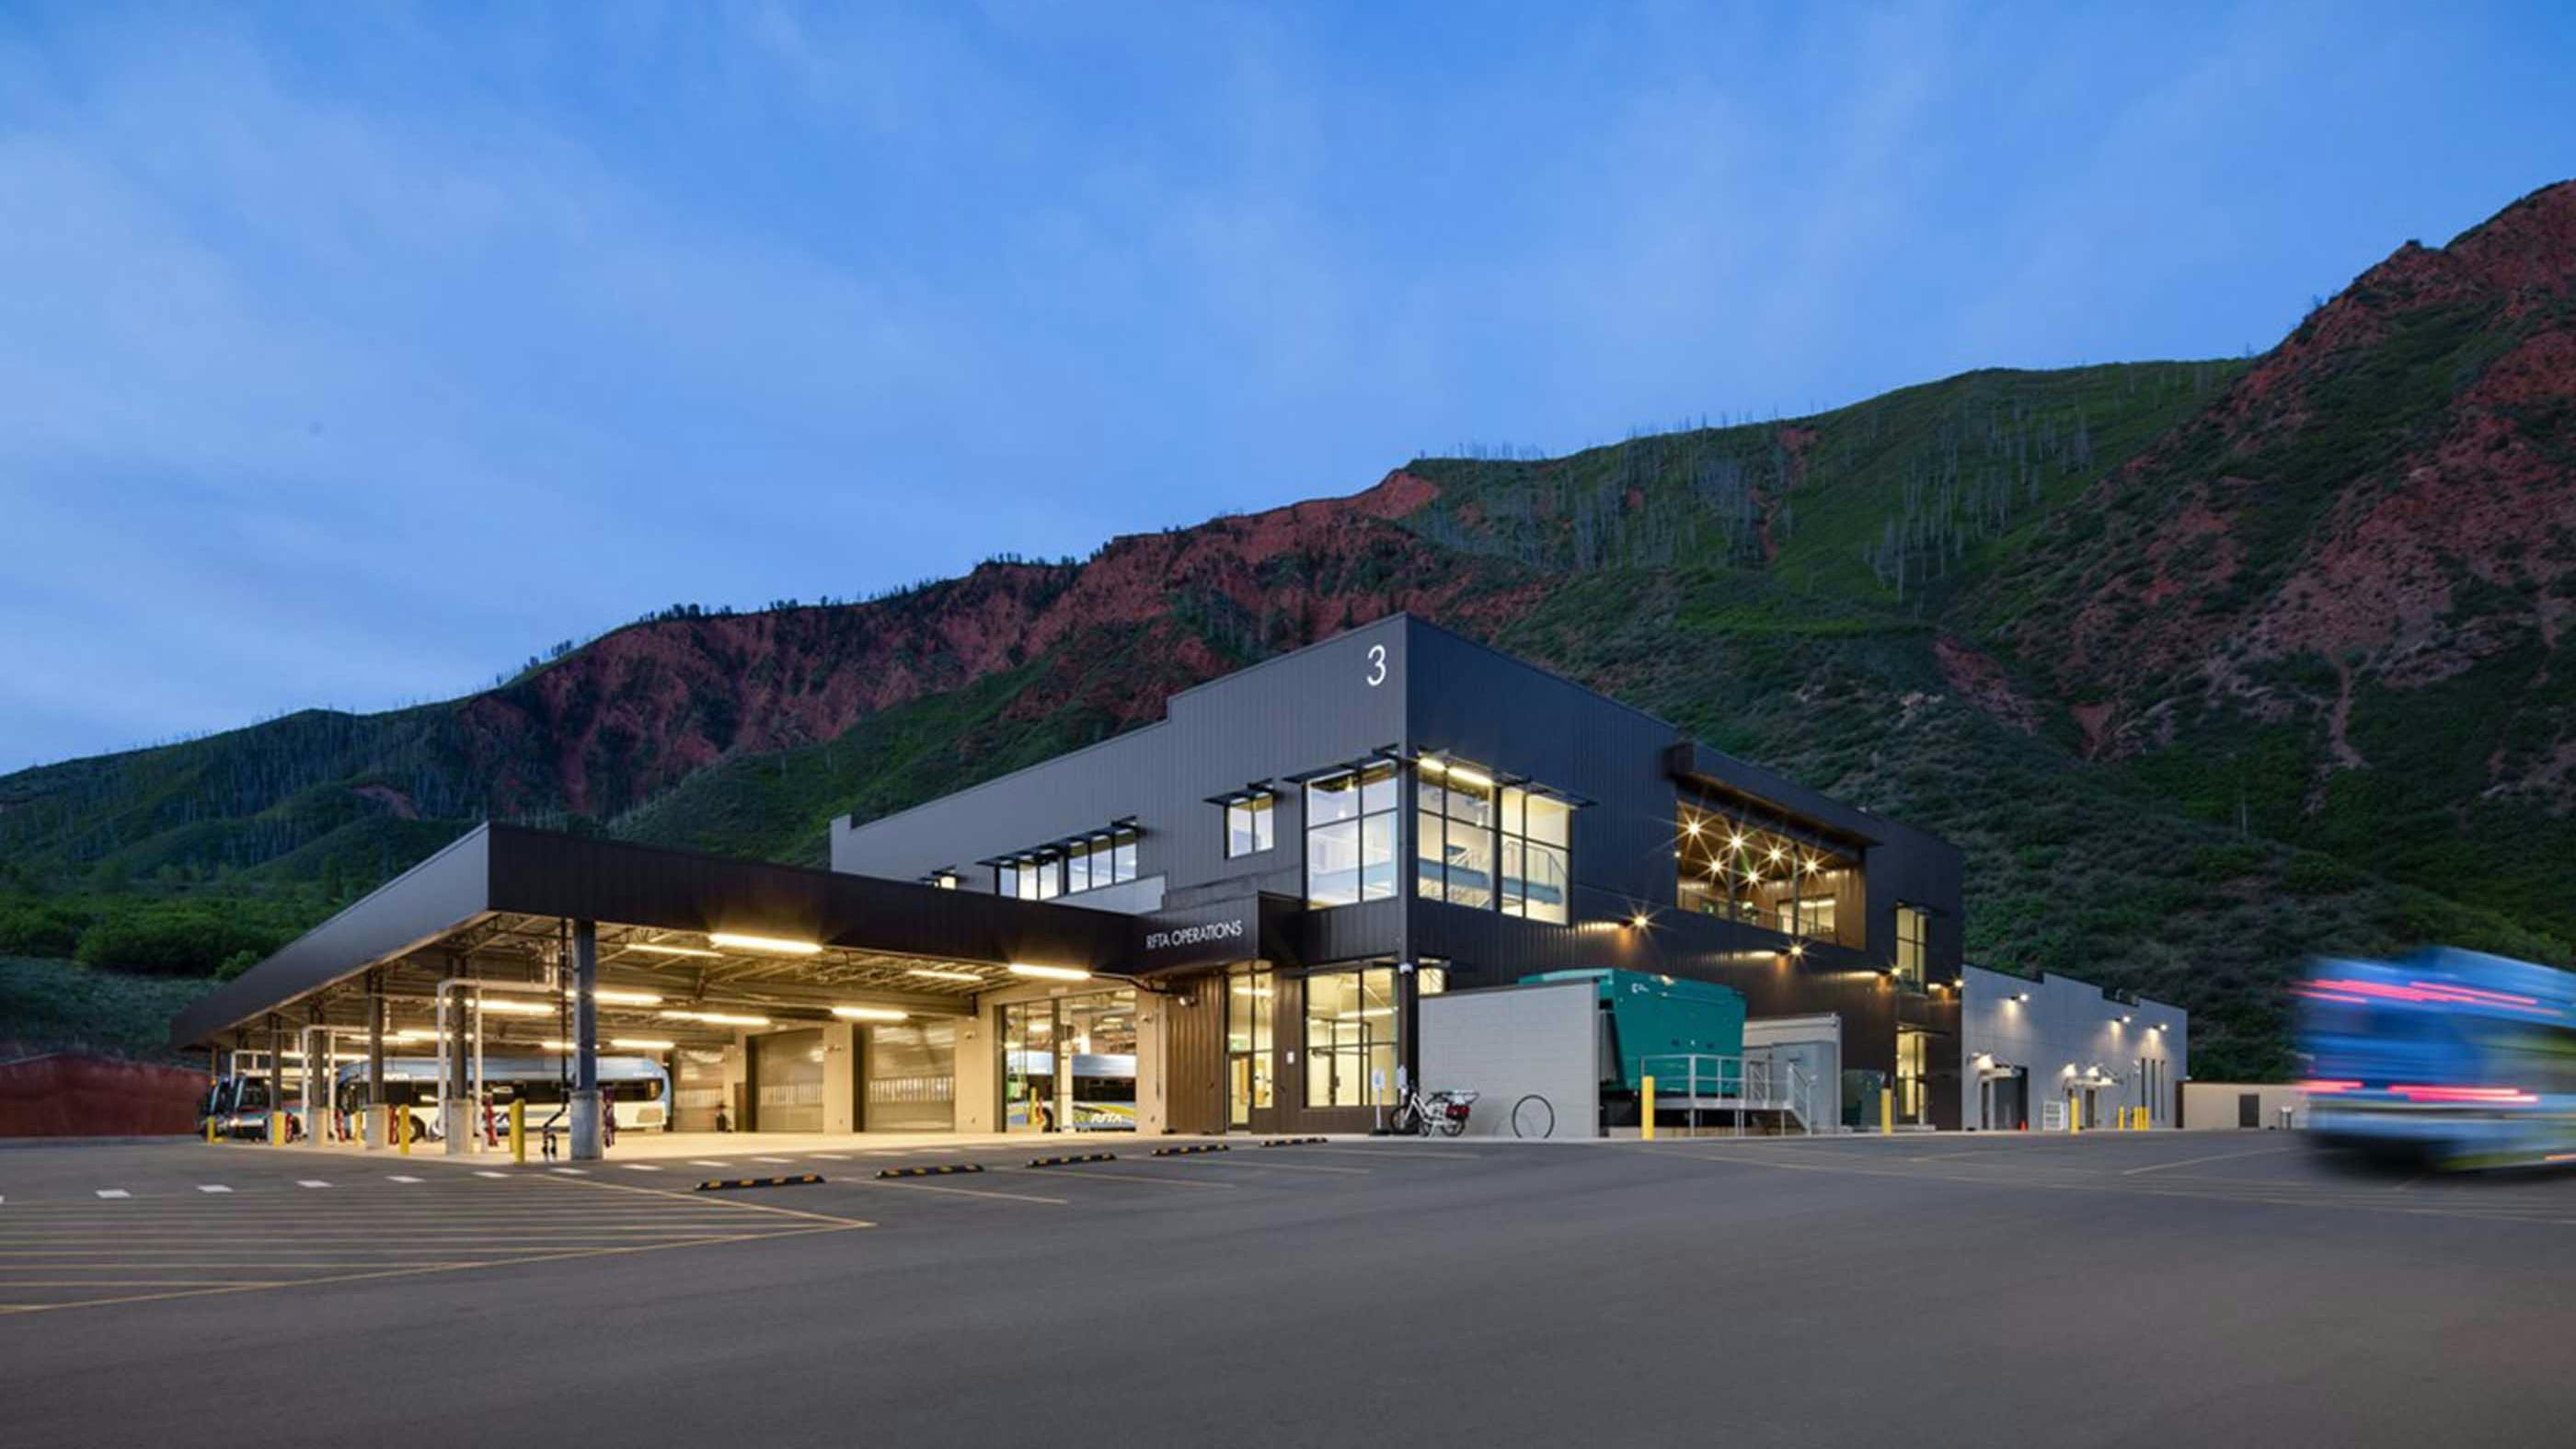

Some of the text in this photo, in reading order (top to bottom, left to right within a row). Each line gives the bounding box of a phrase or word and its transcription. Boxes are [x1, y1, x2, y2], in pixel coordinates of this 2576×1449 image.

[1367, 644, 1386, 686] 3
[1146, 920, 1243, 949] RFTA OPERATIONS
